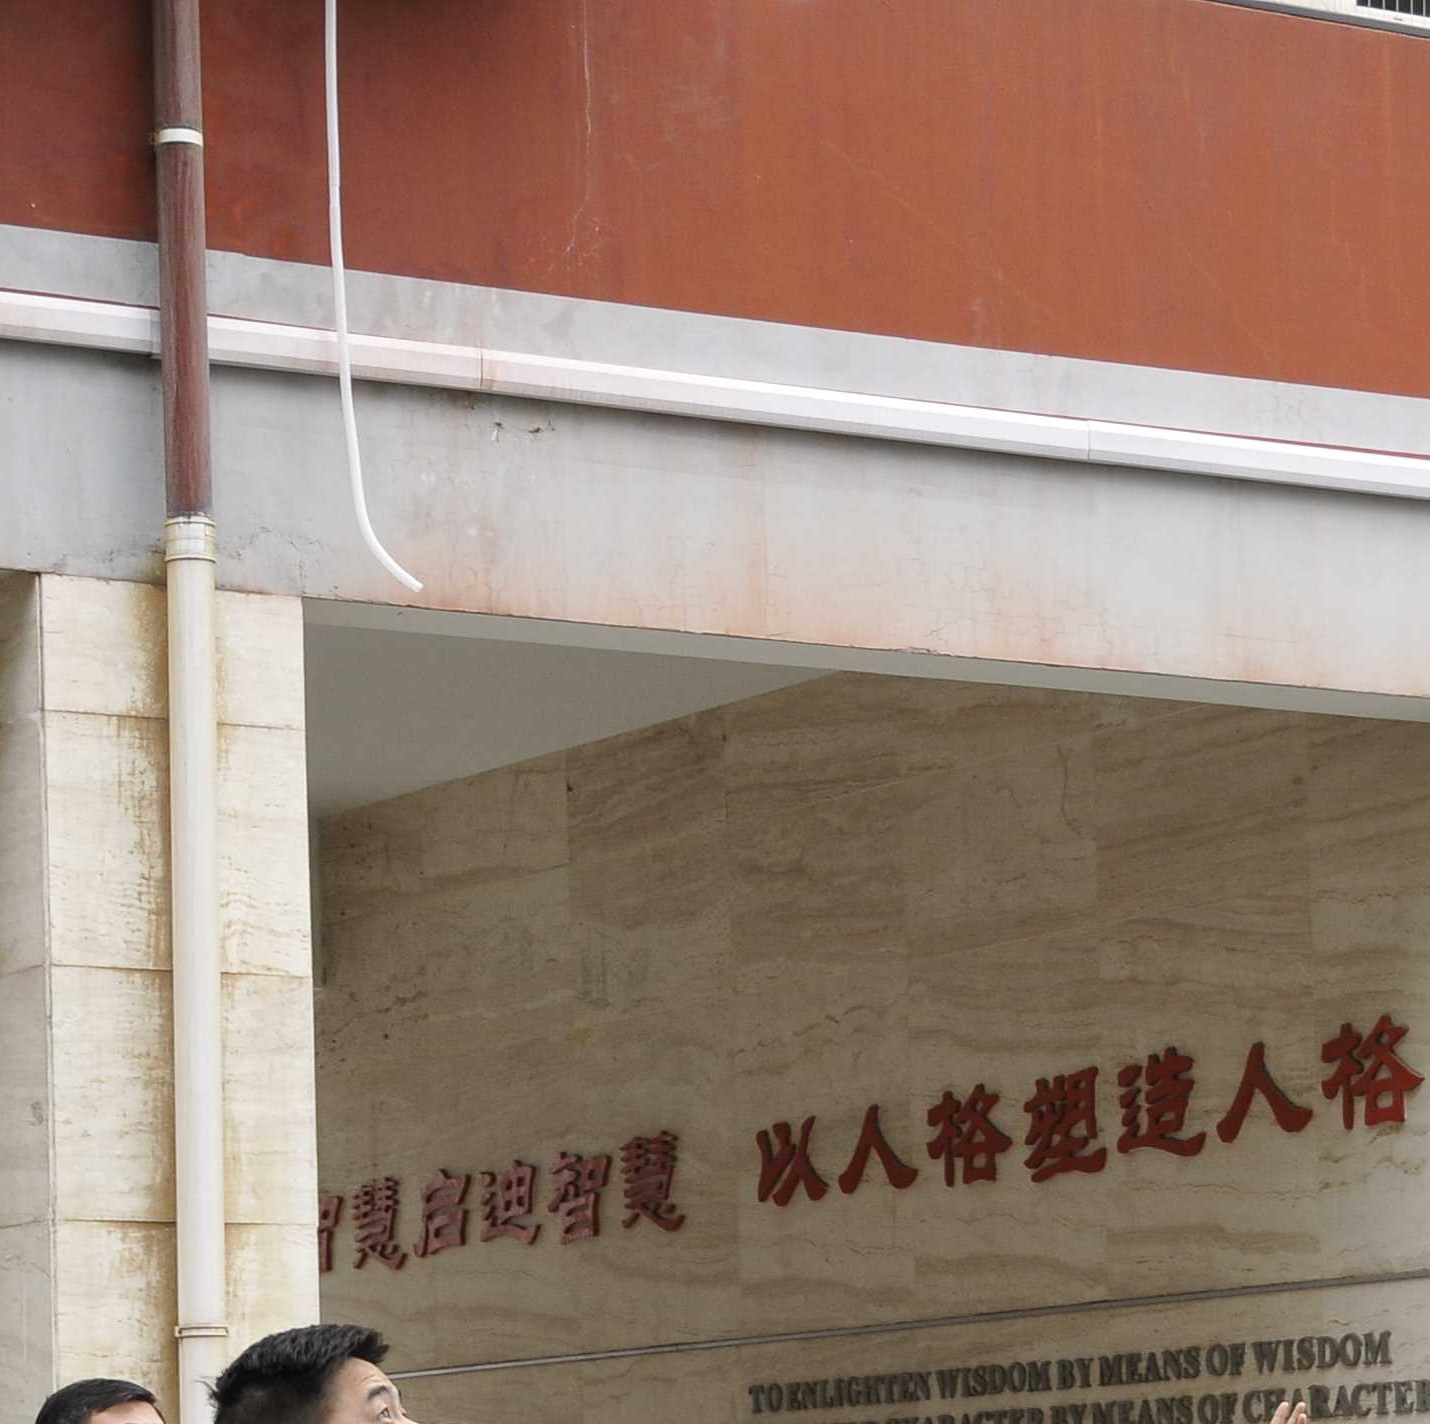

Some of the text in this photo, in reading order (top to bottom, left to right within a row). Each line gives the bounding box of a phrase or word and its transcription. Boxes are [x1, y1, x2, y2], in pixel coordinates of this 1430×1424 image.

[756, 1014, 1426, 1207] 以人格塑造人格
[748, 1329, 1393, 1415] TO ENLIGHTEN WISDOM BY MEANS OF WISDOM
